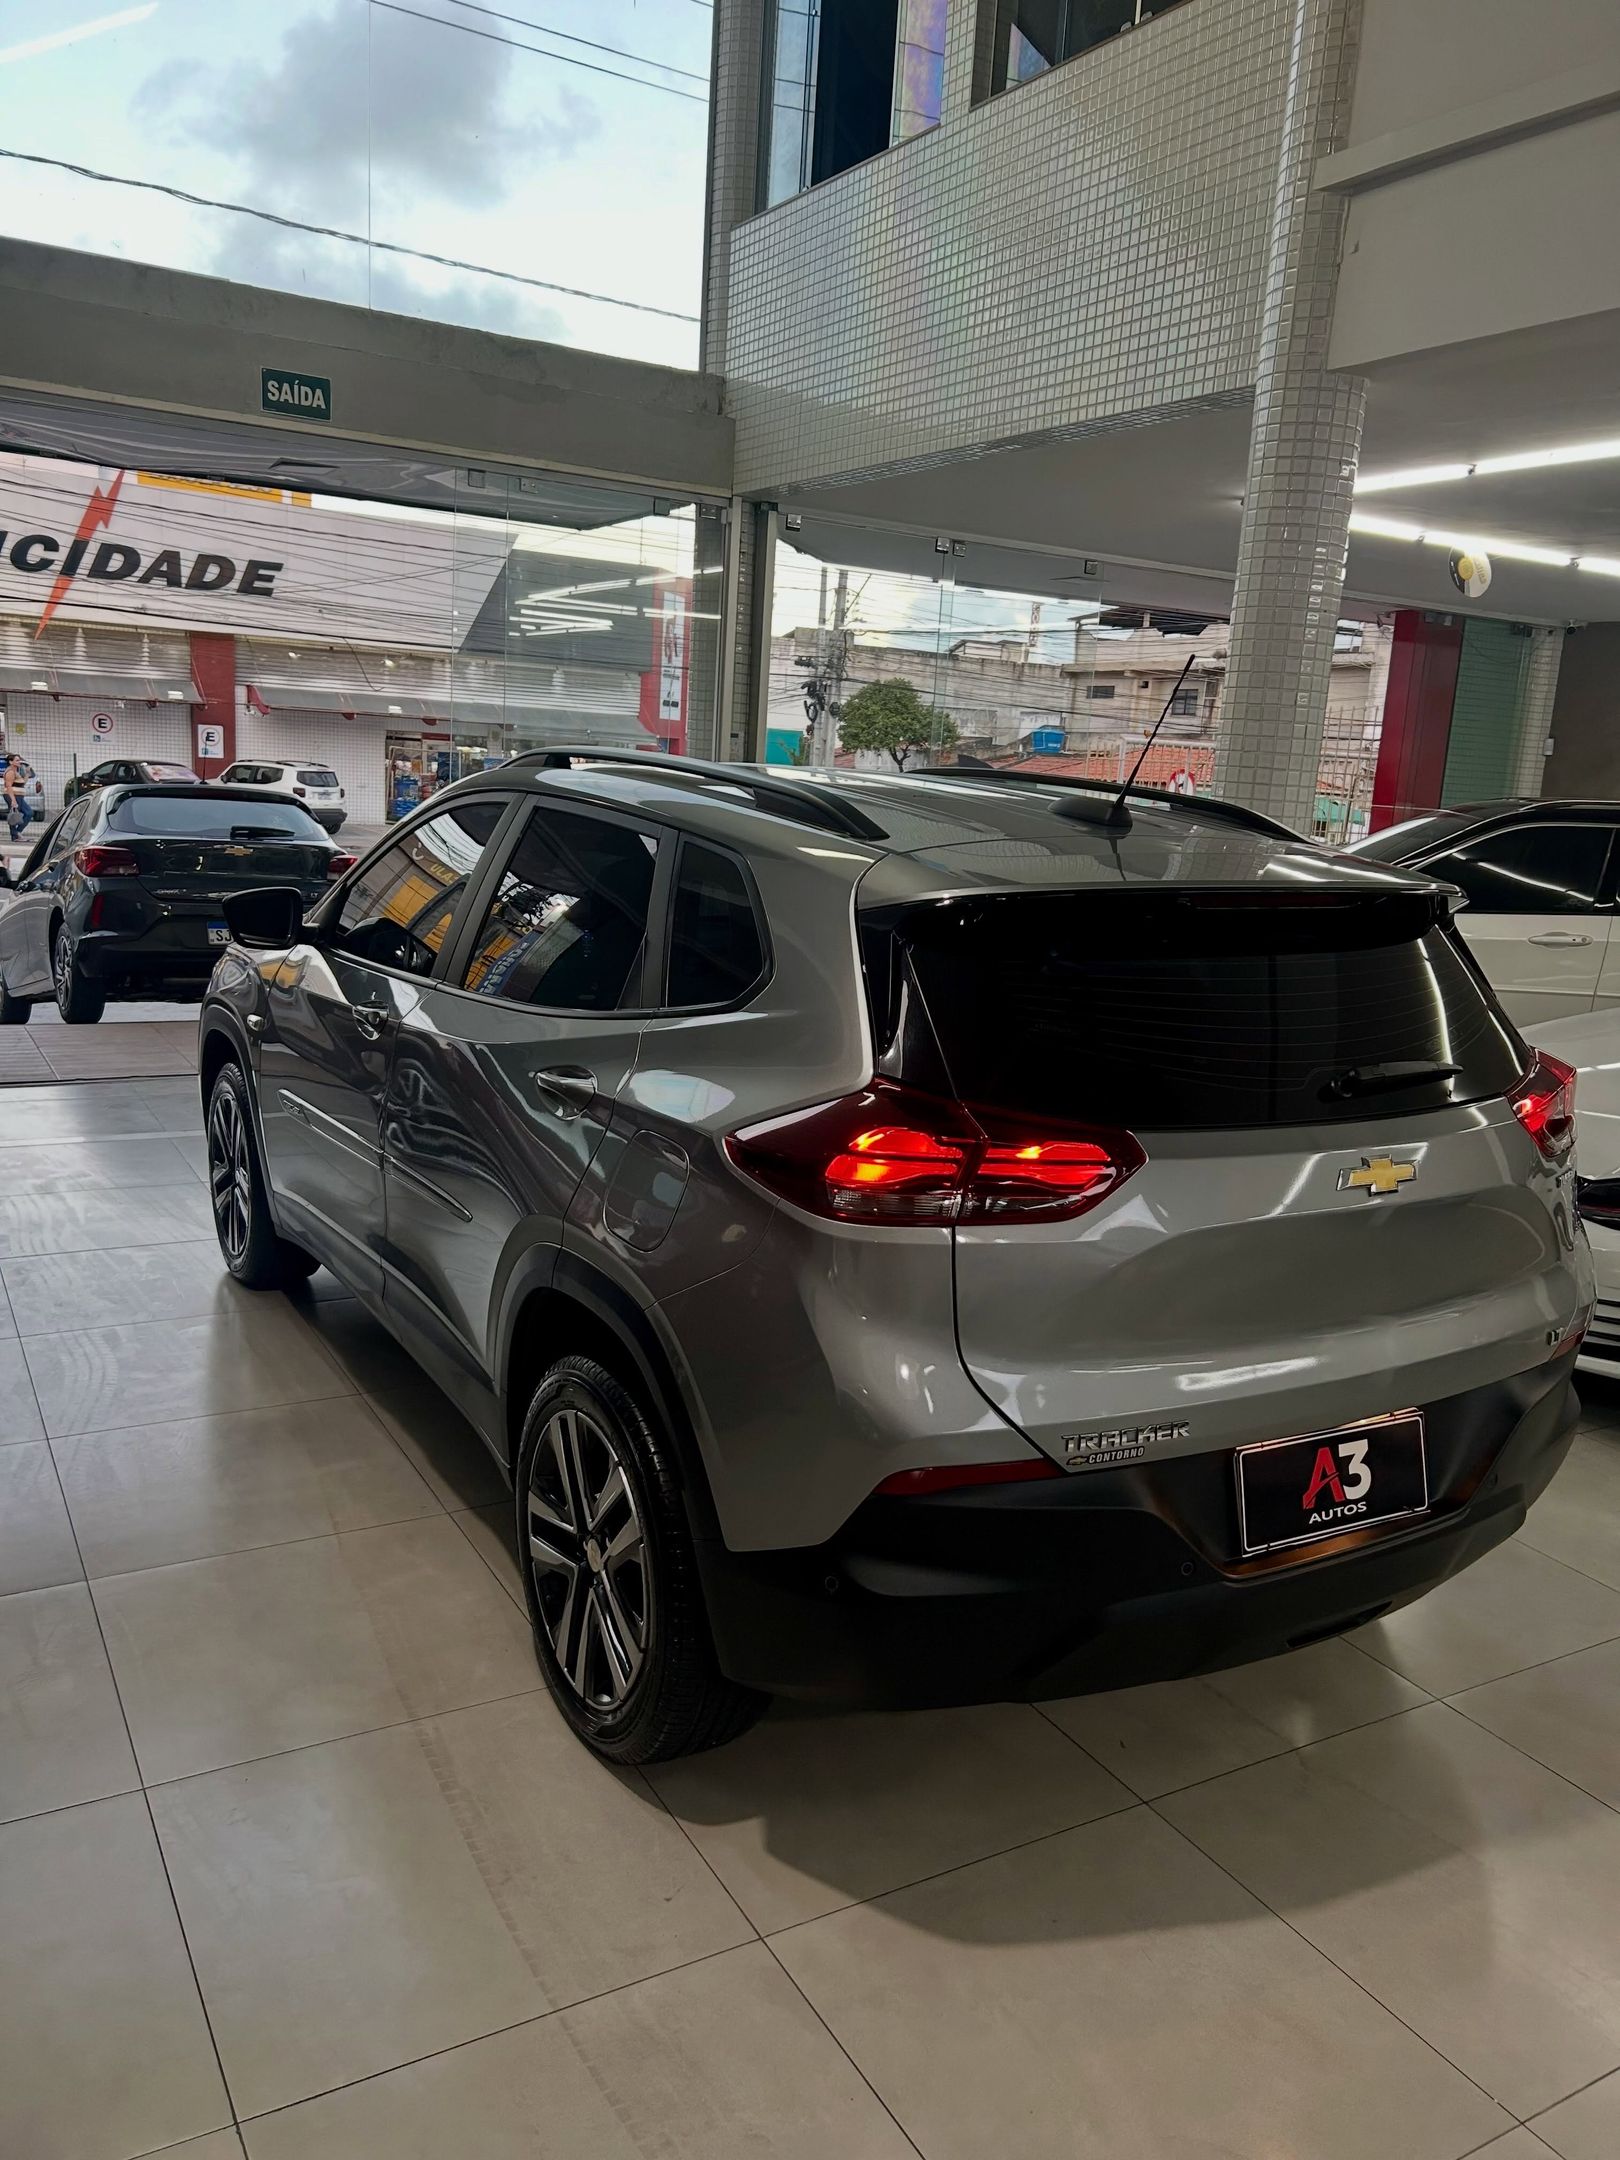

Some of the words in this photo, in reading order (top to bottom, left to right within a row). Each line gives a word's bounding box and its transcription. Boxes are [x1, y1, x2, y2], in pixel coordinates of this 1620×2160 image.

[267, 380, 327, 409] SAÍDA
[98, 718, 108, 729] E
[206, 732, 216, 742] E
[1061, 1420, 1190, 1452] TRACKER
[1088, 1447, 1145, 1463] CONTORNO
[1303, 1439, 1372, 1509] A3
[1308, 1501, 1367, 1524] AUTOS
